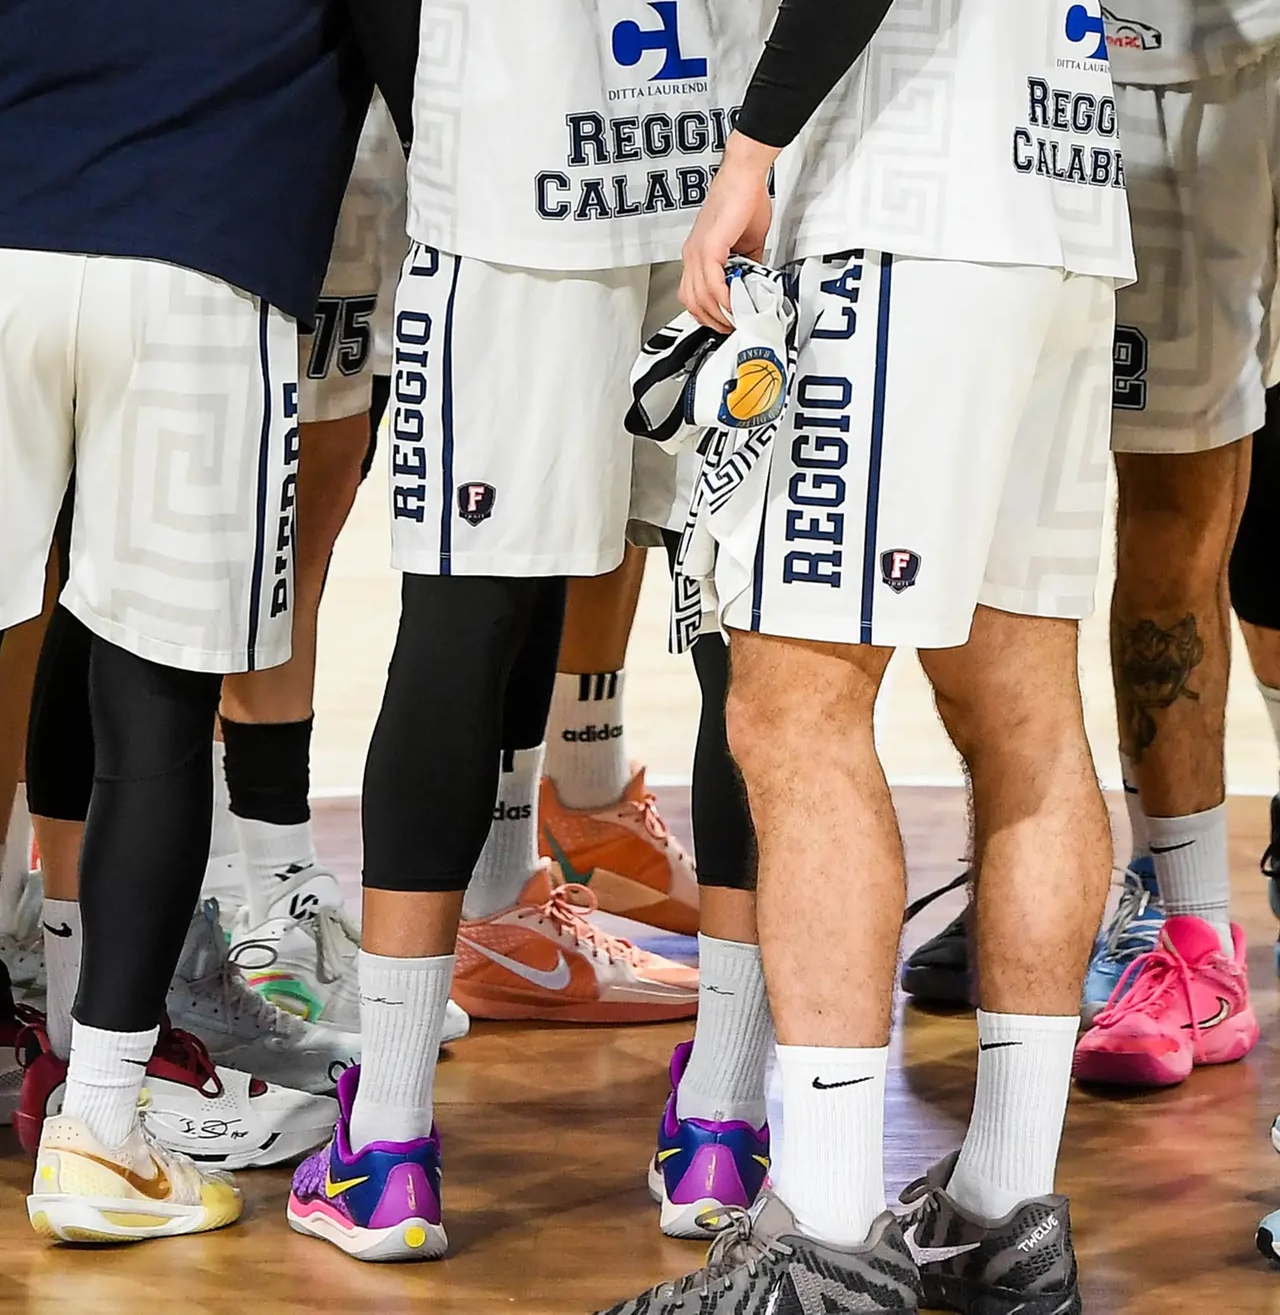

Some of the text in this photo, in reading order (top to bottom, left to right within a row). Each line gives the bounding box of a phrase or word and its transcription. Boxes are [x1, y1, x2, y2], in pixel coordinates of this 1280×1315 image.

[608, 82, 709, 101] DITTA LAURENDI
[1026, 76, 1119, 139] REGG
[566, 105, 743, 167] REGGI
[305, 293, 378, 379] 75
[392, 309, 433, 523] REGGIO
[782, 375, 854, 589] REGGIO
[1017, 1214, 1059, 1252] TWELVE
